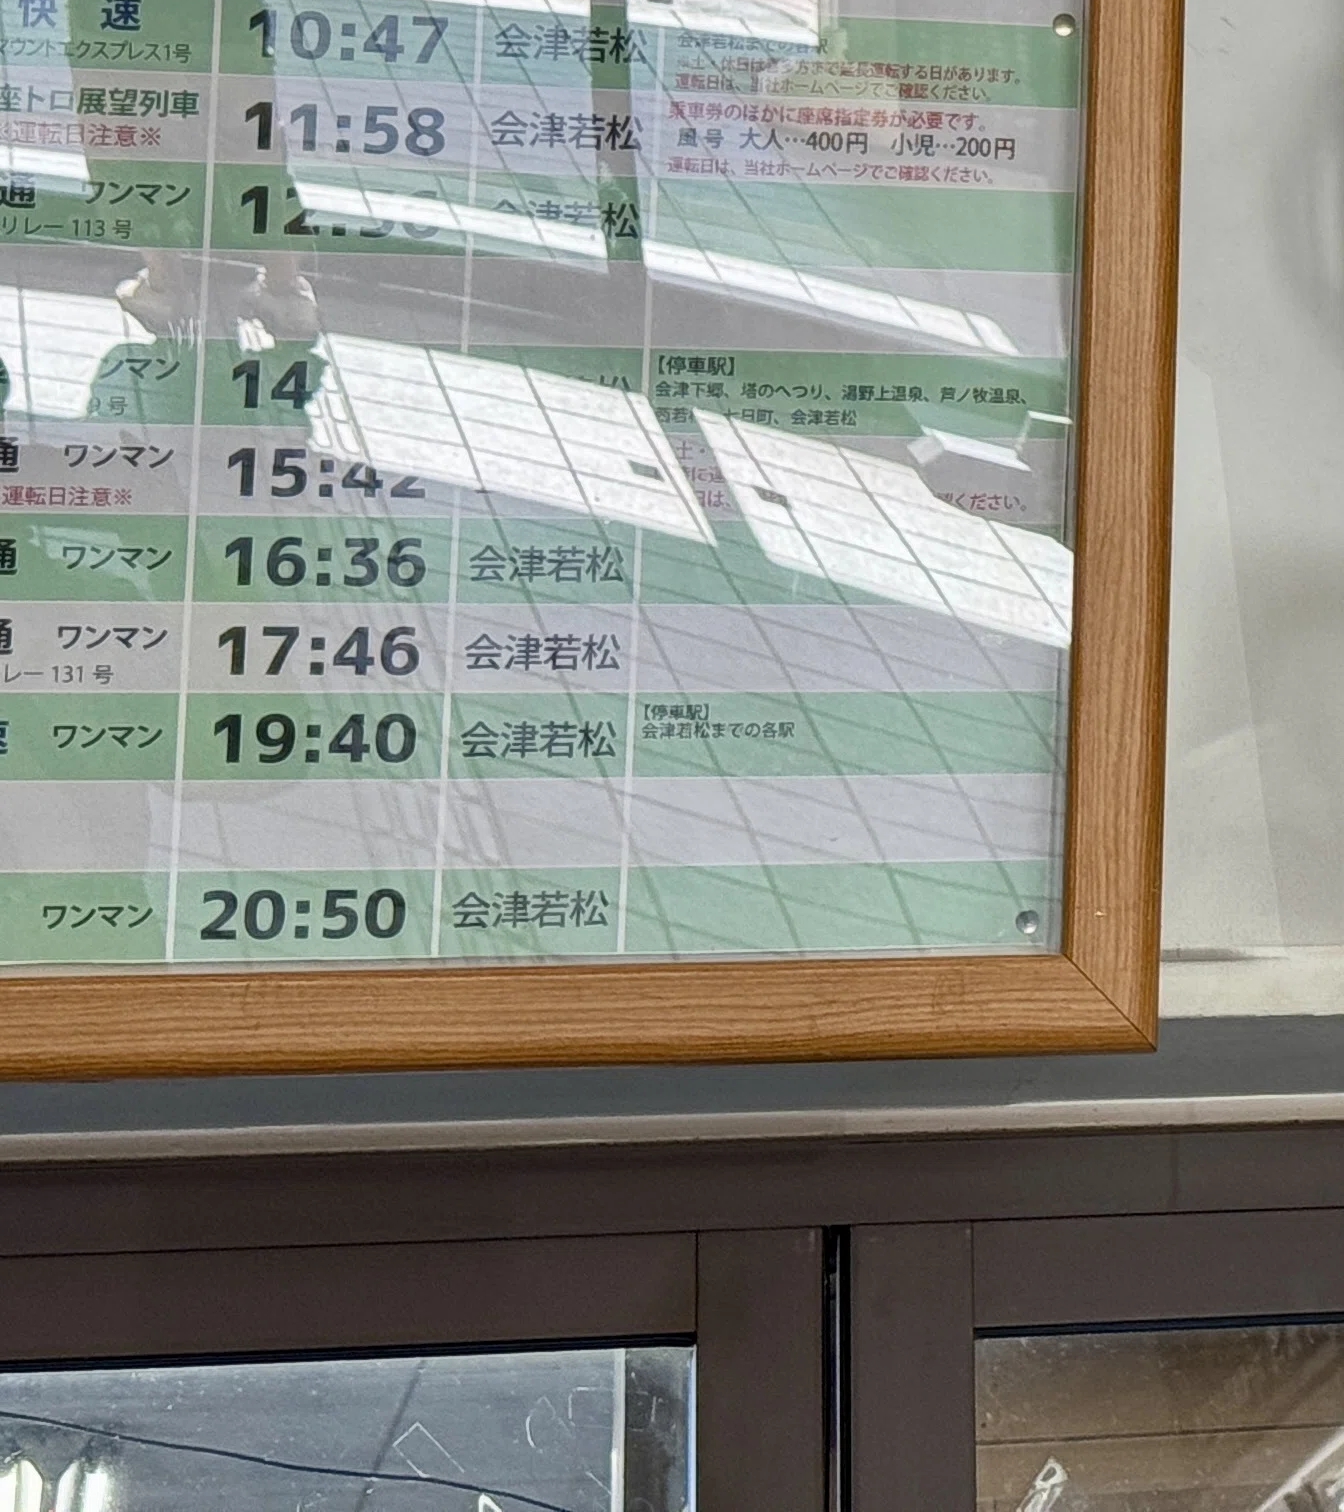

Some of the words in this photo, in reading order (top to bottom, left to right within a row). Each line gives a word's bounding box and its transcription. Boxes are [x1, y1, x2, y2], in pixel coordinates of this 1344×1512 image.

[248, 9, 450, 65] 10:47
[494, 23, 648, 65] 会津若松
[244, 101, 446, 156] 11:58
[491, 110, 644, 152] 会津若松
[82, 180, 191, 206] ワンマン
[63, 444, 174, 469] ワンマン
[62, 546, 172, 569] ワンマン
[224, 536, 427, 588] 16:36
[469, 544, 624, 583] 会津若松
[57, 626, 168, 650] ワンマン
[218, 626, 420, 677] 17:46
[464, 632, 622, 672] 会津若松
[53, 725, 163, 749] ワンマン
[213, 714, 417, 764] 19:40
[460, 720, 617, 759] 会津若松
[642, 721, 795, 741] 会津若松までの各駅
[42, 903, 153, 930] ワンマン
[200, 889, 406, 941] 20:50
[451, 889, 609, 930] 会津若松
